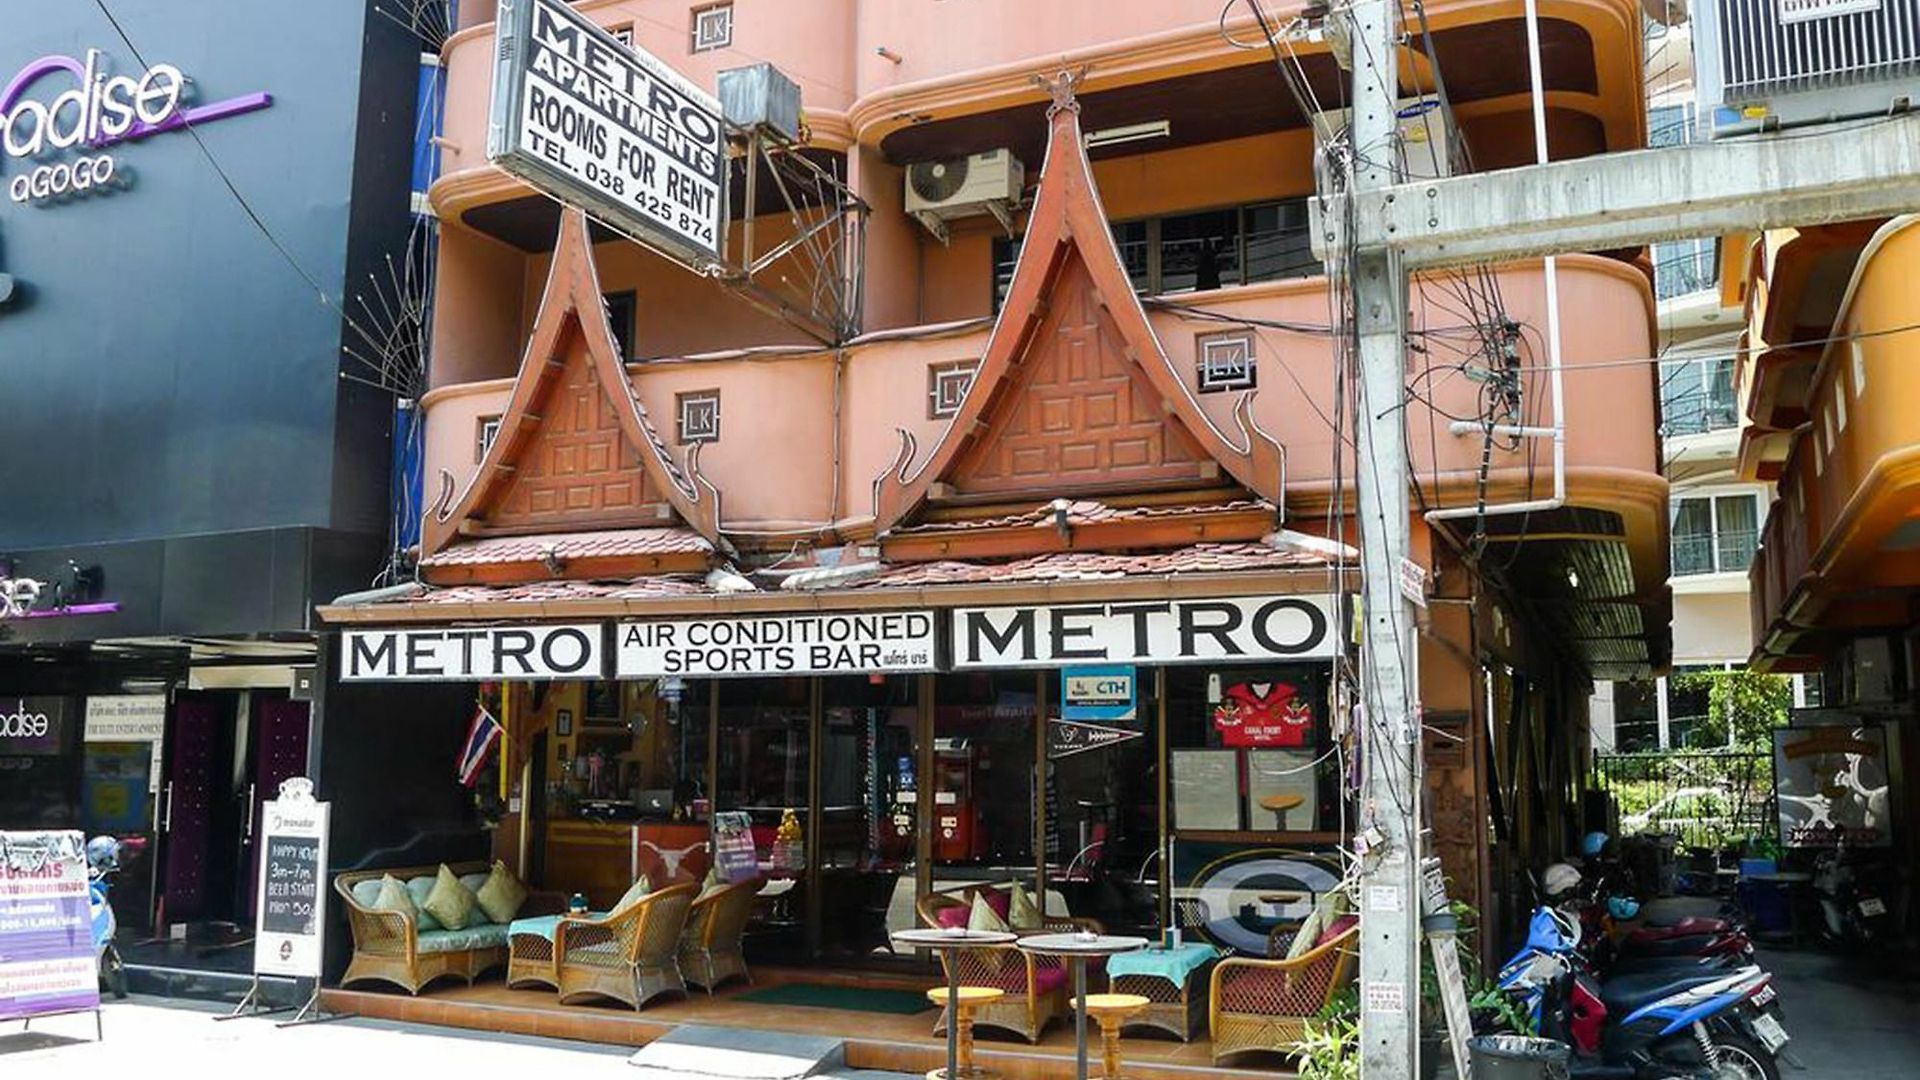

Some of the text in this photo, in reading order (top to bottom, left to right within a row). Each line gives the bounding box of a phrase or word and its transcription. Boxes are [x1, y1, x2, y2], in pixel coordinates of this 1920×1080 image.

[0, 48, 186, 157] adise
[533, 46, 716, 177] APARTMENTS
[537, 6, 716, 146] METRO
[528, 129, 714, 244] TEL. 038 425 874
[530, 84, 715, 220] ROOMS FOR RENT
[349, 627, 592, 676] METRO
[624, 614, 930, 647] AIR CONDITIONED
[664, 643, 882, 672] SPORTS BAR
[966, 598, 1328, 663] METRO
[1096, 681, 1126, 694] CTH
